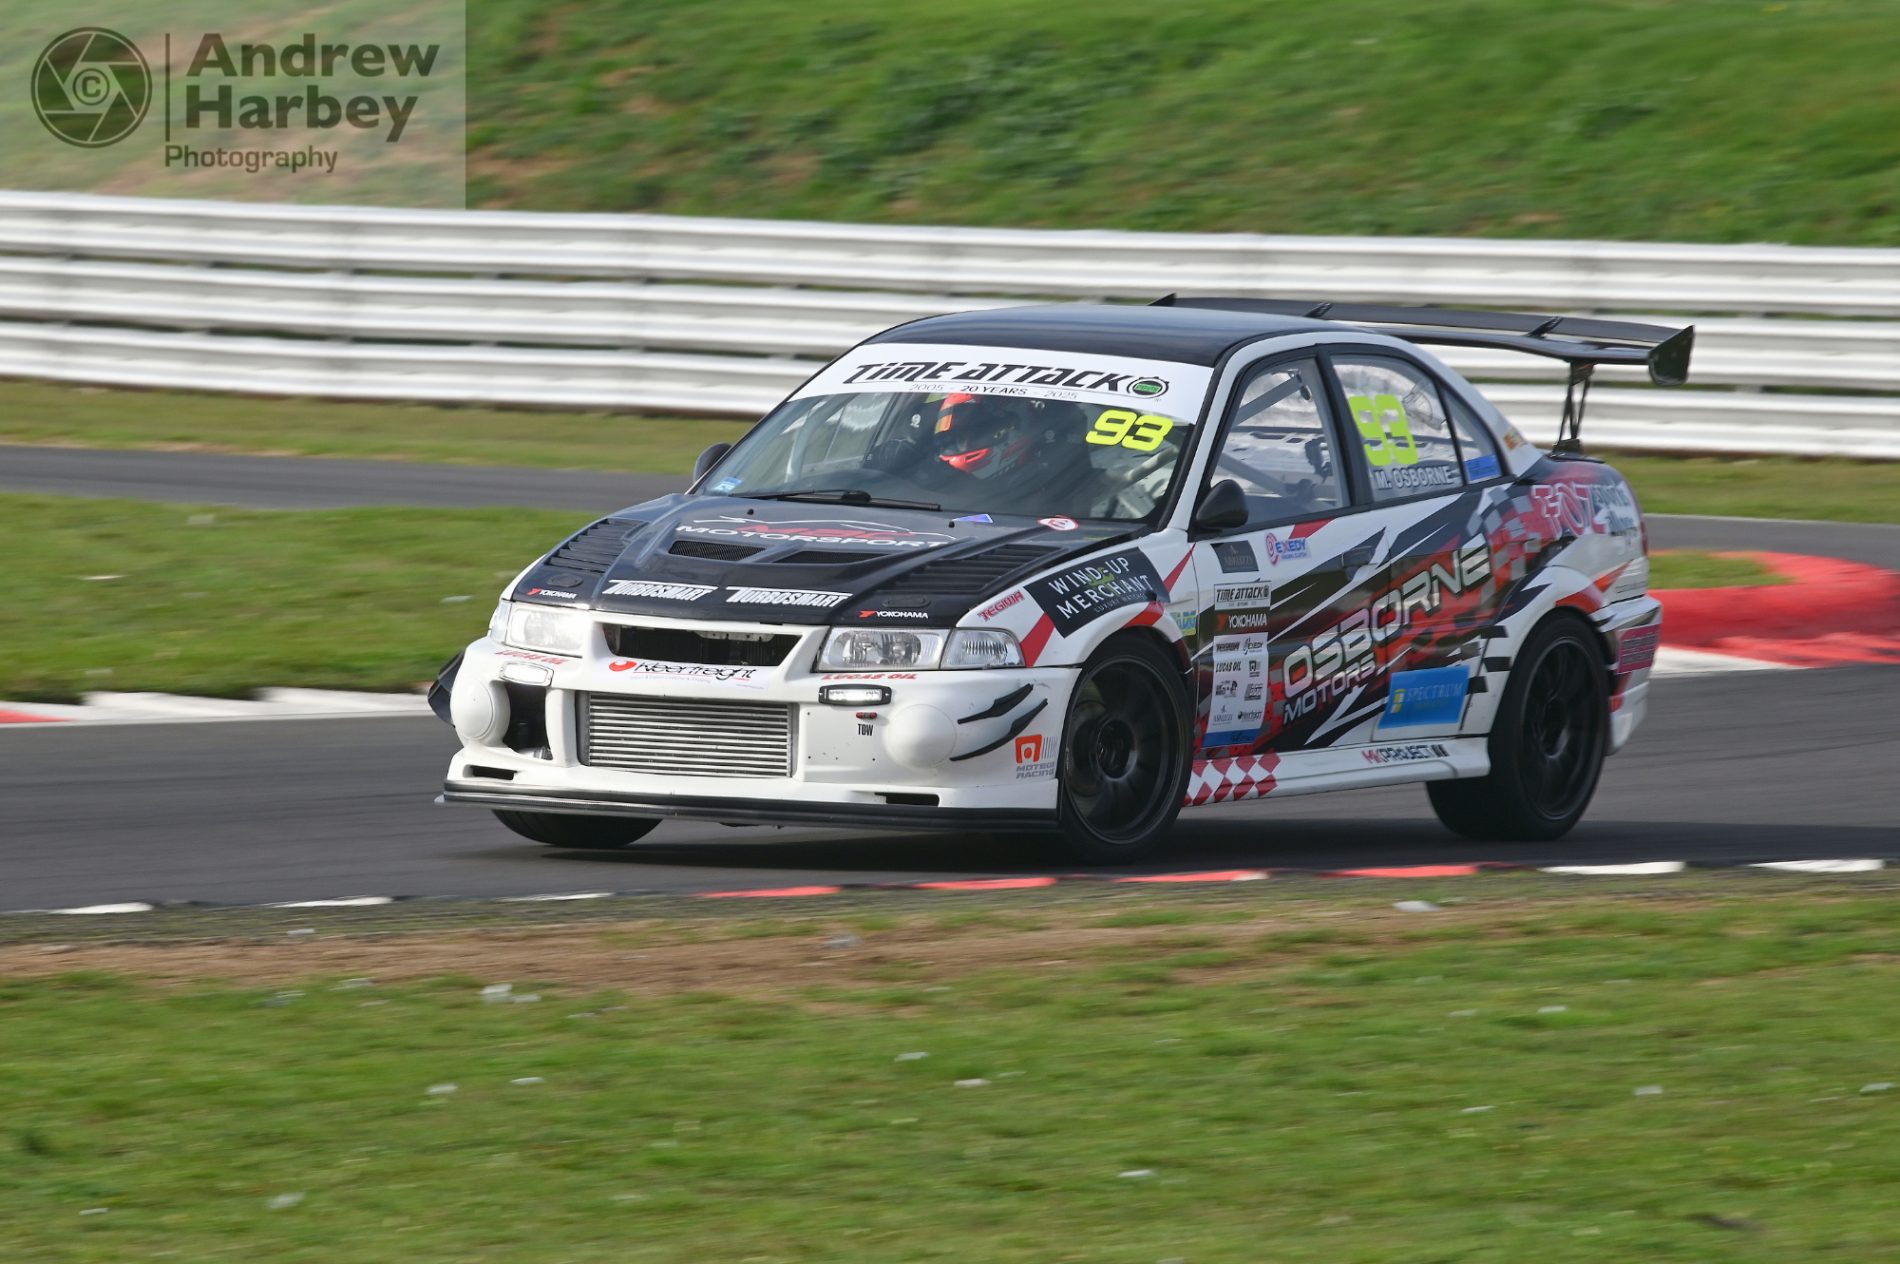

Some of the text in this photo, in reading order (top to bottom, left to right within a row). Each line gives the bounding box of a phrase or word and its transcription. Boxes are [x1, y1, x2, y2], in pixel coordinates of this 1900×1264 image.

[952, 362, 1136, 392] ATTACK
[909, 383, 1078, 399] 2005 20 YEARS 2025
[1085, 409, 1174, 452] 93
[1348, 394, 1419, 467] 93
[1374, 470, 1393, 490] M.
[1393, 465, 1452, 489] OSBORNE
[676, 525, 950, 547] MOTORSPORT
[1275, 538, 1306, 553] EXEDY
[1048, 557, 1130, 595] WIND-UP
[539, 589, 577, 600] YOKOHAMA
[602, 580, 718, 601] TURBOSMART
[726, 586, 853, 608] TURBOSMART
[1056, 575, 1154, 620] MERCHANT
[1234, 586, 1263, 600] ATTACK
[875, 610, 929, 619] YOKOHAMA
[978, 591, 1024, 622] TEGIWA
[1282, 532, 1492, 699] OSBORNE
[1228, 613, 1268, 628] YOKOHAMA
[821, 673, 886, 681] LUCAS
[1215, 661, 1242, 673] LUCAS OIL
[1283, 652, 1378, 725] MOTORS
[857, 723, 874, 737] TOW
[1015, 767, 1055, 780] RACING
